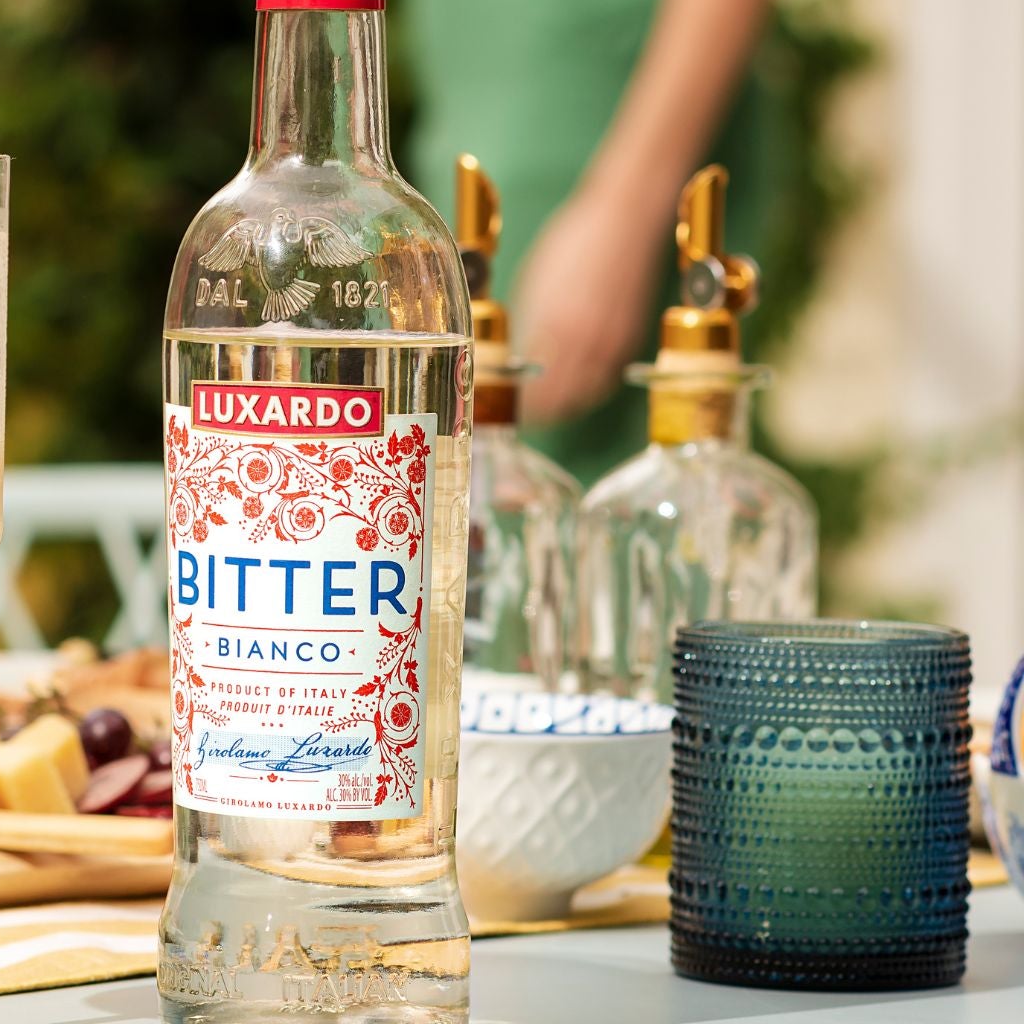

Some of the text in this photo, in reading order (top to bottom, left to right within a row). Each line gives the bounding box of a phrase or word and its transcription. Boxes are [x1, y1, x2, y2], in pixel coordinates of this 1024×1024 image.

[195, 278, 248, 307] DAL
[332, 280, 390, 309] 1821
[199, 391, 372, 428] LUXARDO
[178, 550, 408, 616] BITTER
[218, 637, 341, 662] BIANCO
[211, 682, 348, 699] PRODUCT OF ITALY
[220, 701, 334, 716] PRODUIT D'ITALIE
[194, 731, 374, 770] Girolamo Luxardo
[220, 797, 332, 811] GIROLAMO LUXARDO
